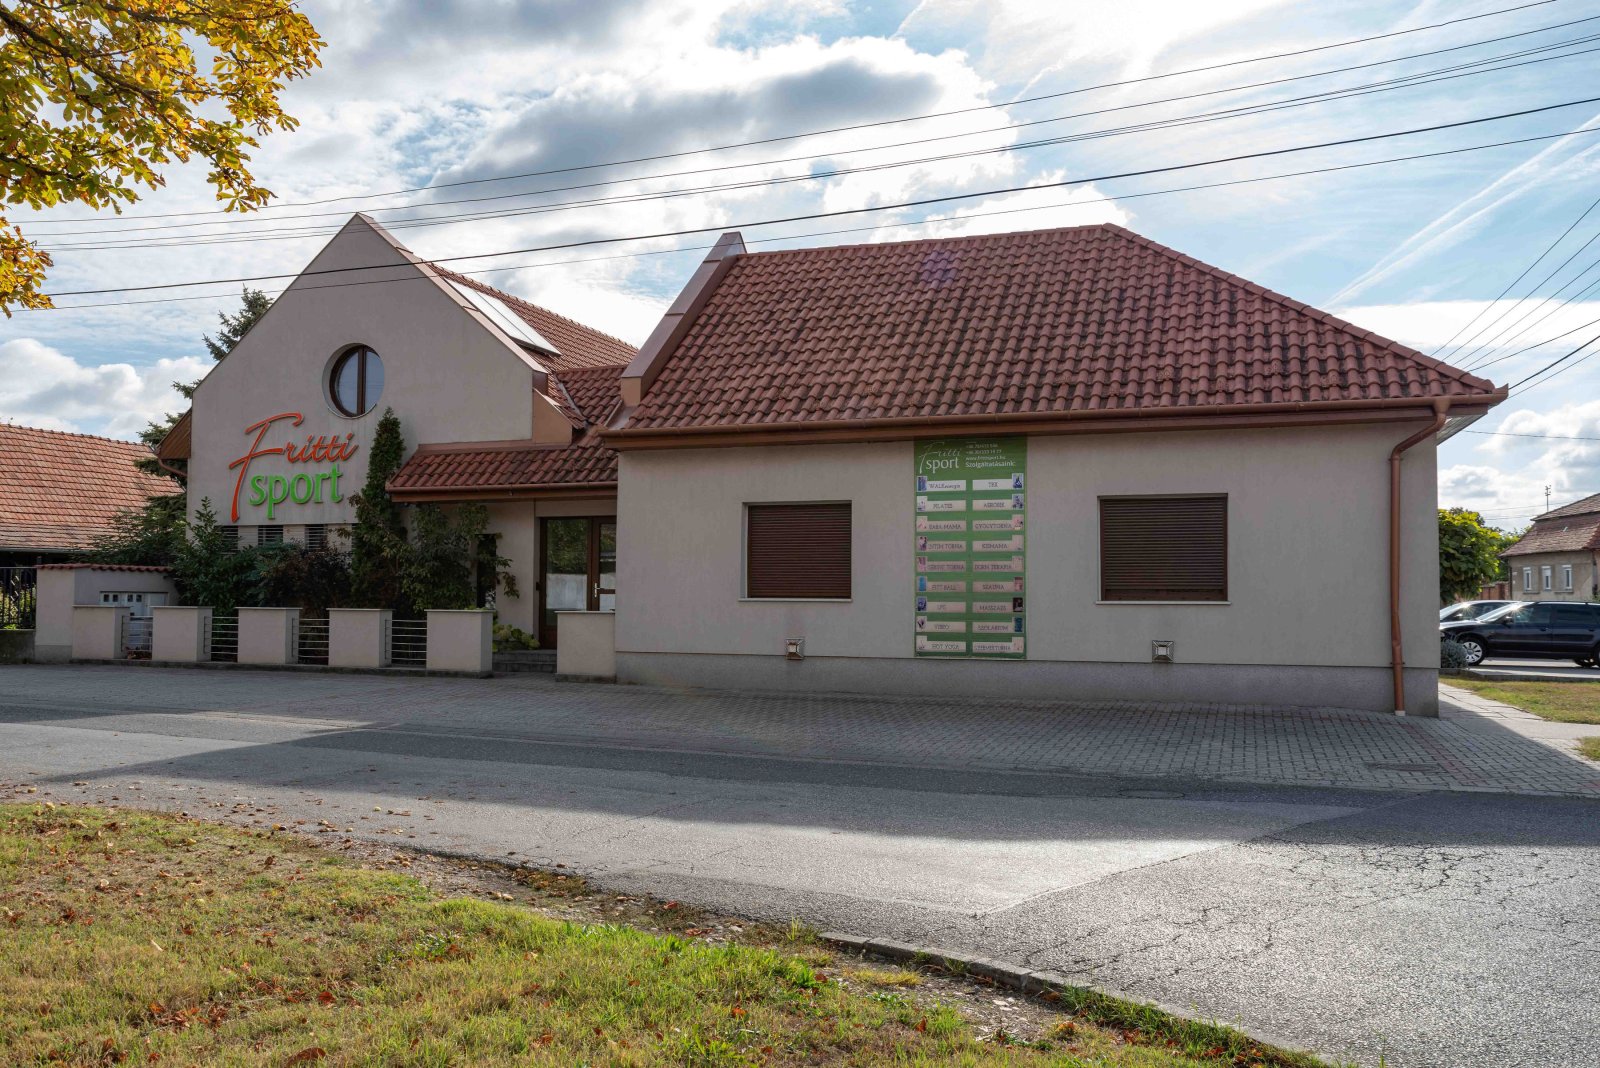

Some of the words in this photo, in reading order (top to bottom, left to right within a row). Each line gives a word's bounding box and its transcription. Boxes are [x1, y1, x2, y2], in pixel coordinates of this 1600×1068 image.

[229, 412, 359, 523] Fritti
[249, 463, 343, 519] sport
[926, 457, 960, 474] sport
